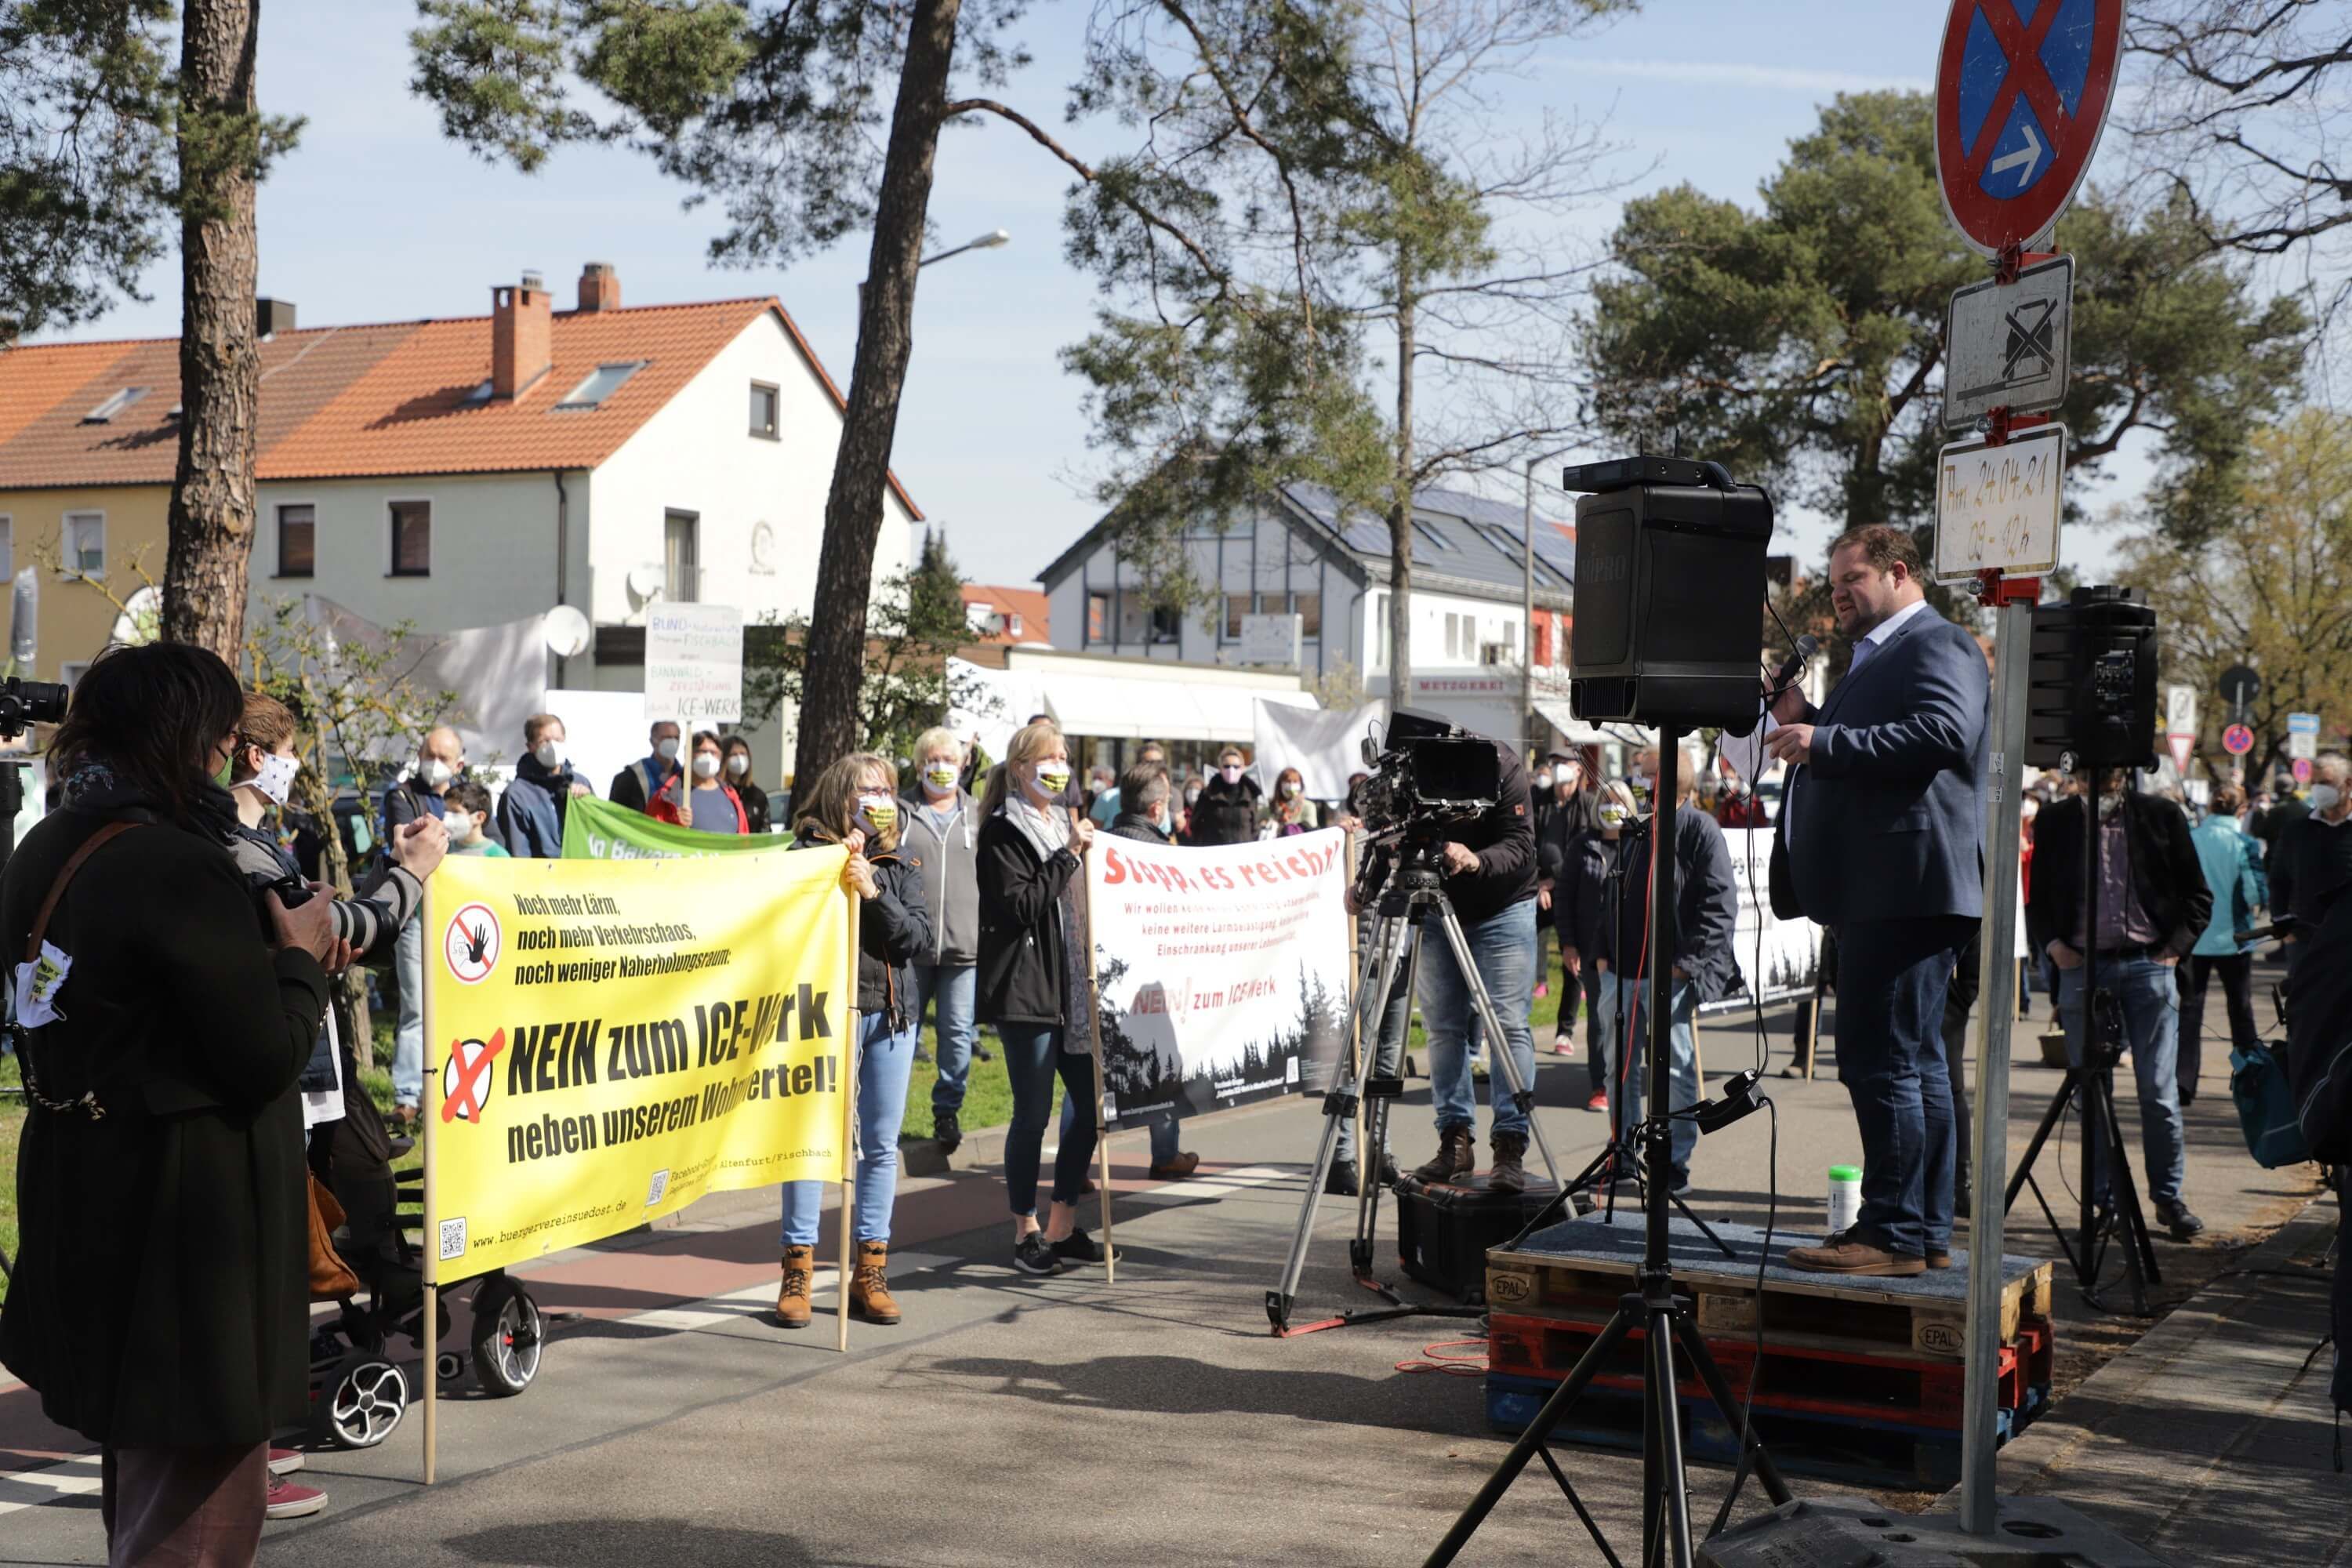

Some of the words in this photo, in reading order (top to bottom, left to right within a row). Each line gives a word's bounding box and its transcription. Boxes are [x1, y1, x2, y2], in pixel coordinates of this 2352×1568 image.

[1945, 465, 1967, 514] Am
[1976, 452, 2049, 507] 24.04.21
[1581, 554, 1626, 583] MIPRO
[1420, 681, 1504, 691] METZGEREI
[677, 696, 740, 716] ICE-WERK
[590, 833, 606, 858] In
[1104, 847, 1200, 894] Stopp,
[1200, 866, 1234, 890] es
[514, 893, 550, 916] Noch
[549, 895, 583, 916] mehr
[583, 894, 620, 916] Lärm,
[1124, 902, 1142, 914] Wir
[1146, 902, 1178, 914] wollen
[517, 926, 556, 950] noch
[559, 926, 594, 948] mehr
[593, 923, 696, 947] Verkehrschaos,
[1142, 924, 1170, 935] keine
[1174, 922, 1209, 935] weitere
[515, 960, 554, 985] noch
[557, 958, 616, 982] weniger
[1193, 990, 1223, 1010] zum
[508, 1018, 602, 1095] NEIN
[608, 1018, 688, 1081] zum
[508, 1113, 597, 1163] neben
[603, 1093, 699, 1146] unserem
[719, 1149, 833, 1168] Altenfurt/Fischbach
[473, 1200, 627, 1249] www.buergervereinsuedost.de
[1497, 1279, 1519, 1295] EPAL
[1925, 1329, 1958, 1347] EPAL
